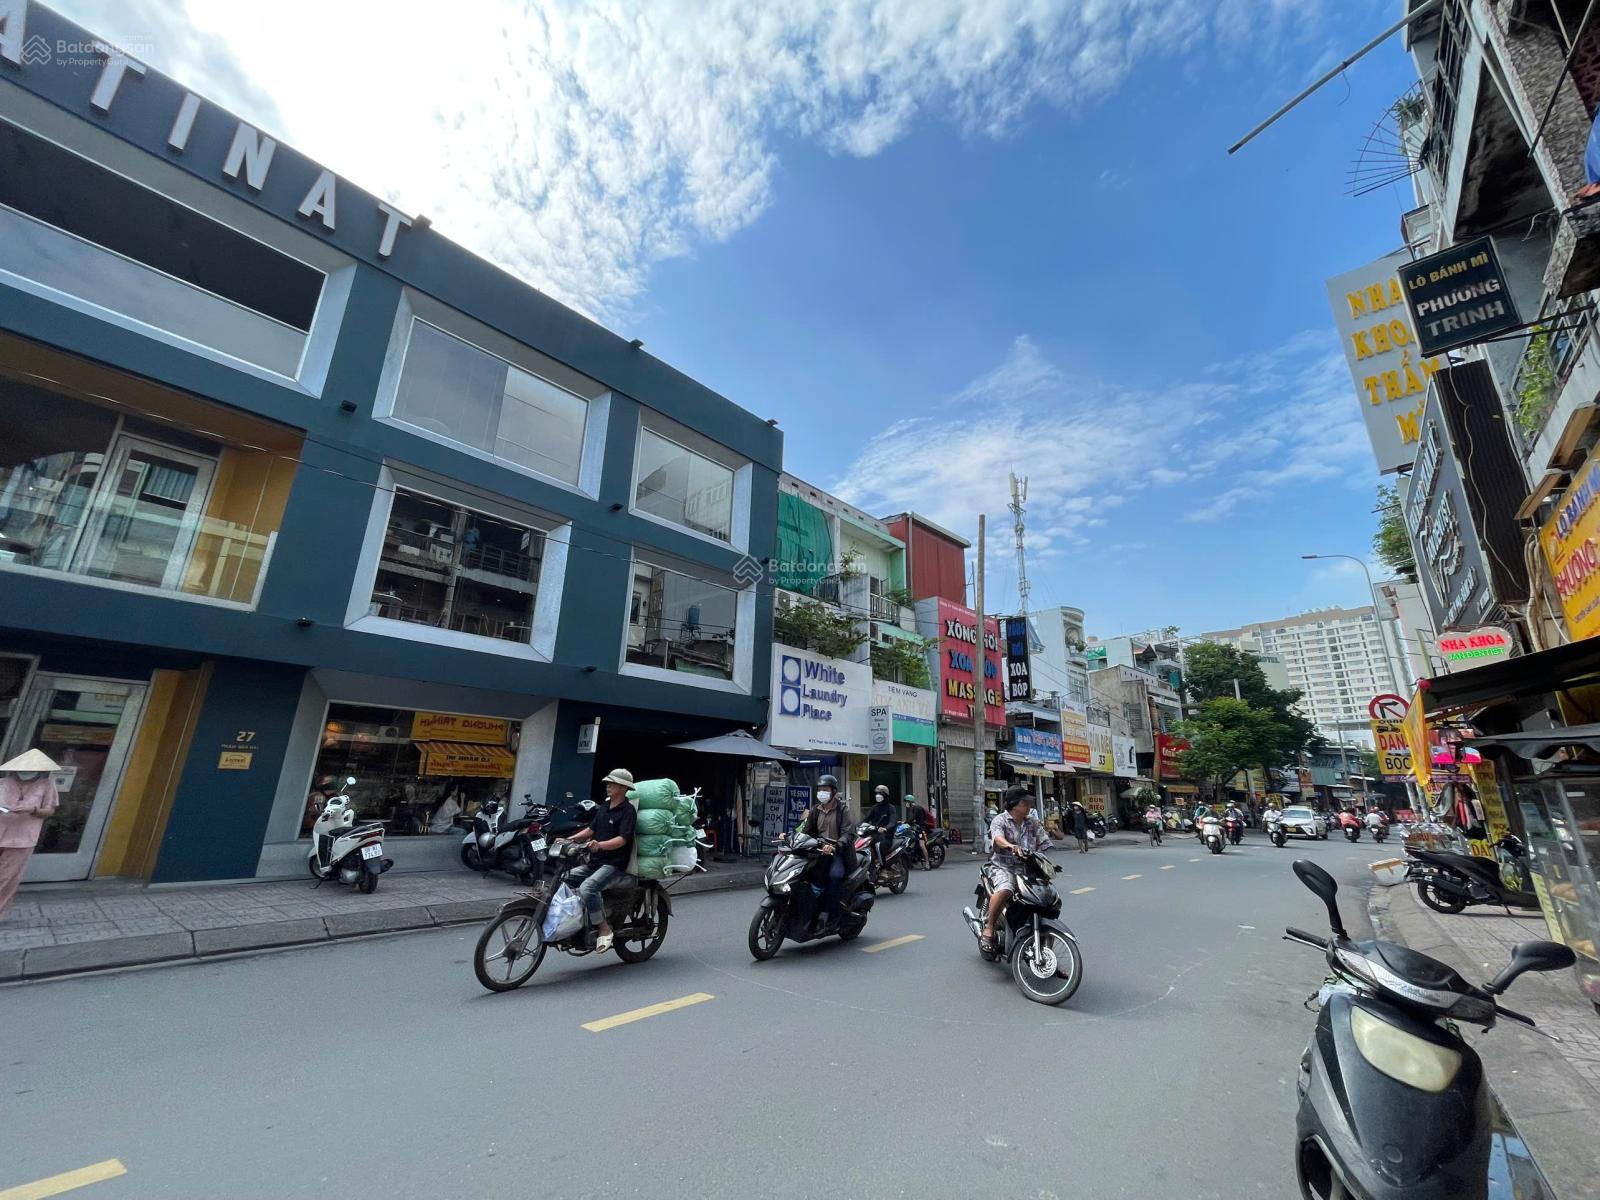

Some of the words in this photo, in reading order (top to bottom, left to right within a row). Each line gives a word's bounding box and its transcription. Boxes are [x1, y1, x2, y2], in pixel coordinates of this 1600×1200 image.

[1408, 275, 1426, 290] LÒ
[1429, 261, 1468, 282] BÁNH
[1470, 251, 1489, 267] MÌ
[1352, 319, 1416, 360] KHO
[1441, 638, 1467, 651] NHA
[1469, 633, 1506, 648] KHOA
[802, 659, 846, 685] White
[1010, 661, 1028, 677] XOA
[802, 683, 848, 708] Laundry
[1012, 679, 1028, 697] BÓP
[801, 703, 833, 721] Place
[871, 708, 887, 717] SPA
[236, 731, 256, 742] 27
